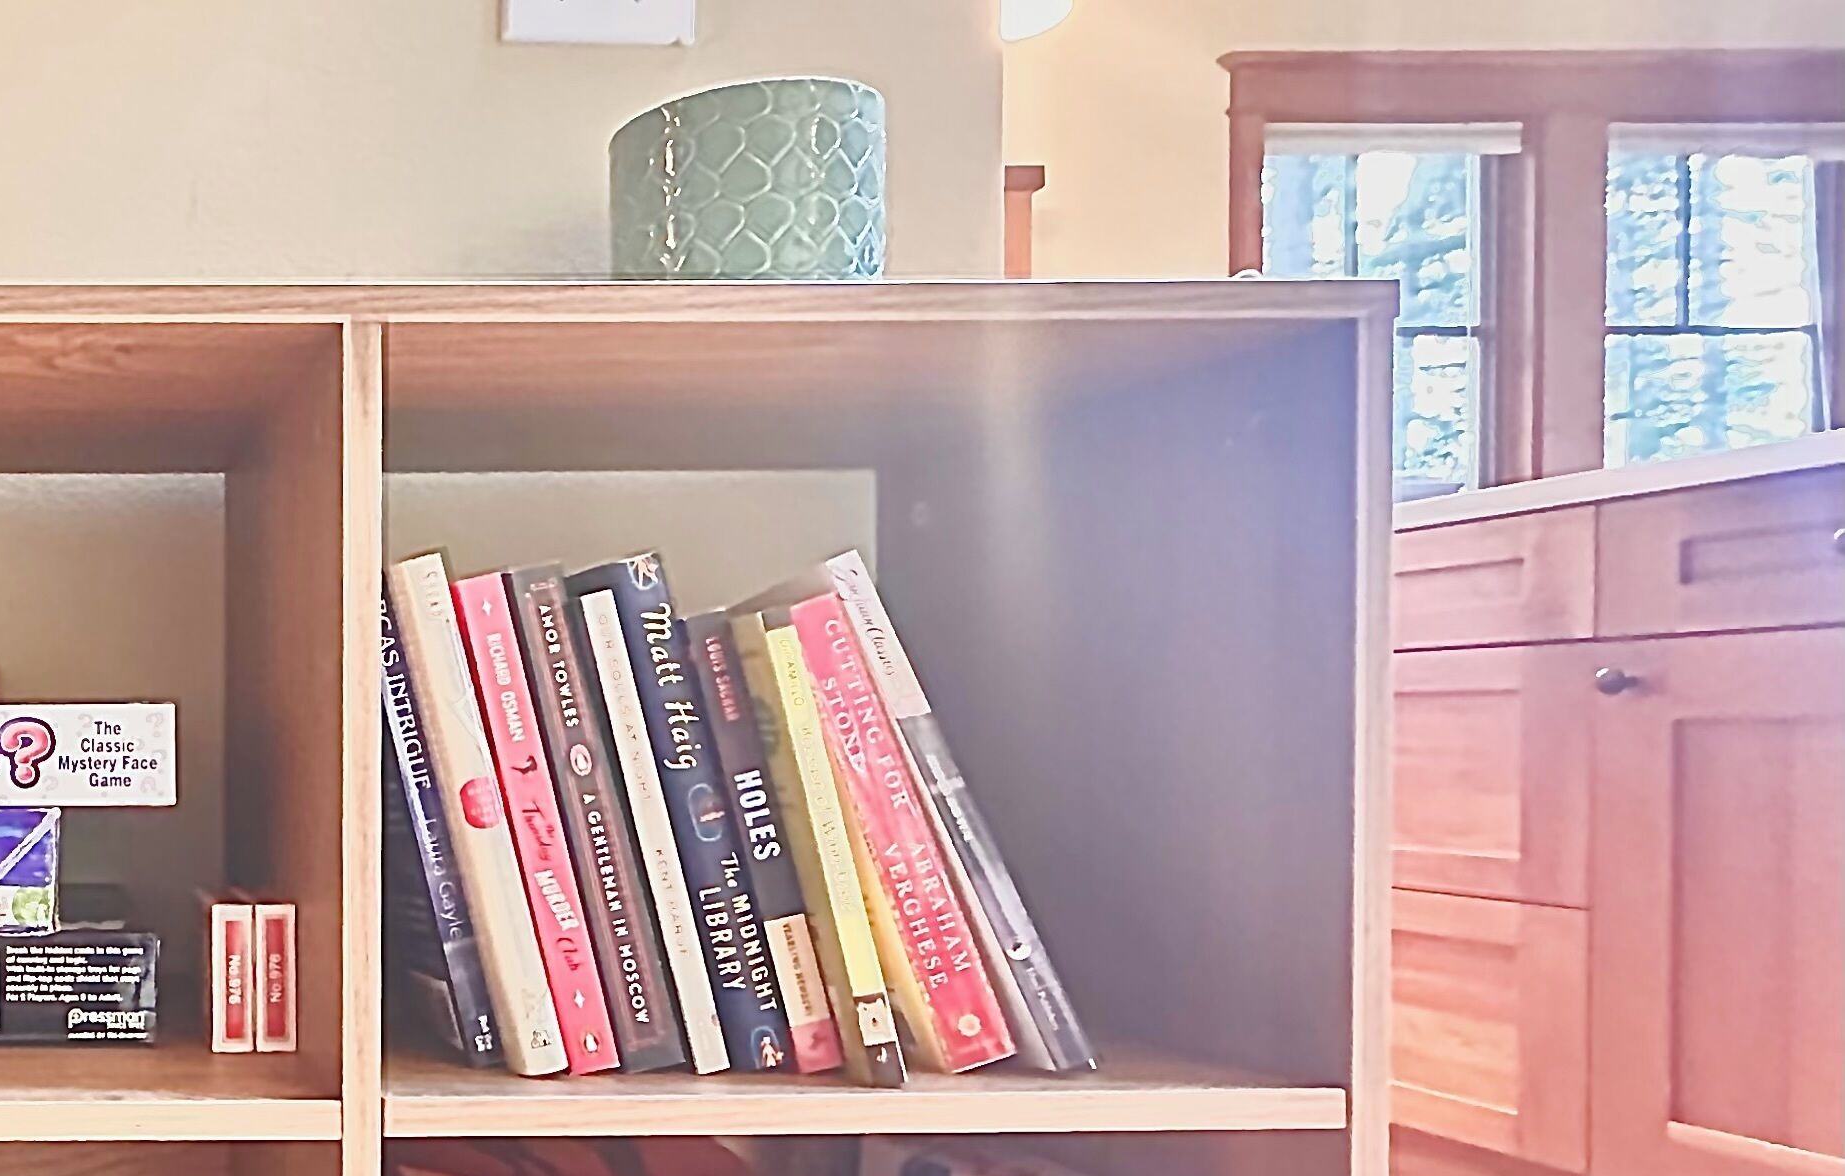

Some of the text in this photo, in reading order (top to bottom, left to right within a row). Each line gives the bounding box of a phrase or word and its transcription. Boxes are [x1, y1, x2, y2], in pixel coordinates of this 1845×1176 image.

[486, 631, 528, 742] RICHARD OSMAN
[538, 602, 582, 728] AMOR TOWLES
[640, 600, 712, 774] Matt Haig
[705, 634, 728, 672] LOUIS
[58, 755, 158, 773] Mystery Face
[80, 738, 134, 752] Classic
[94, 721, 121, 735] The
[388, 672, 431, 789] INTRIGUE
[823, 618, 911, 810] CUTTING FOR
[89, 773, 132, 787] Game
[734, 768, 783, 862] HOLES
[438, 881, 464, 938] Gayle
[535, 865, 580, 933] MURDER
[583, 791, 652, 1024] A GENTLEMAN IN MOSCOW
[699, 884, 748, 992] LIBRARY
[720, 850, 779, 1012] The MIDNIGHT
[884, 843, 950, 991] VERGHESE
[909, 843, 973, 973] ABRAHAM
